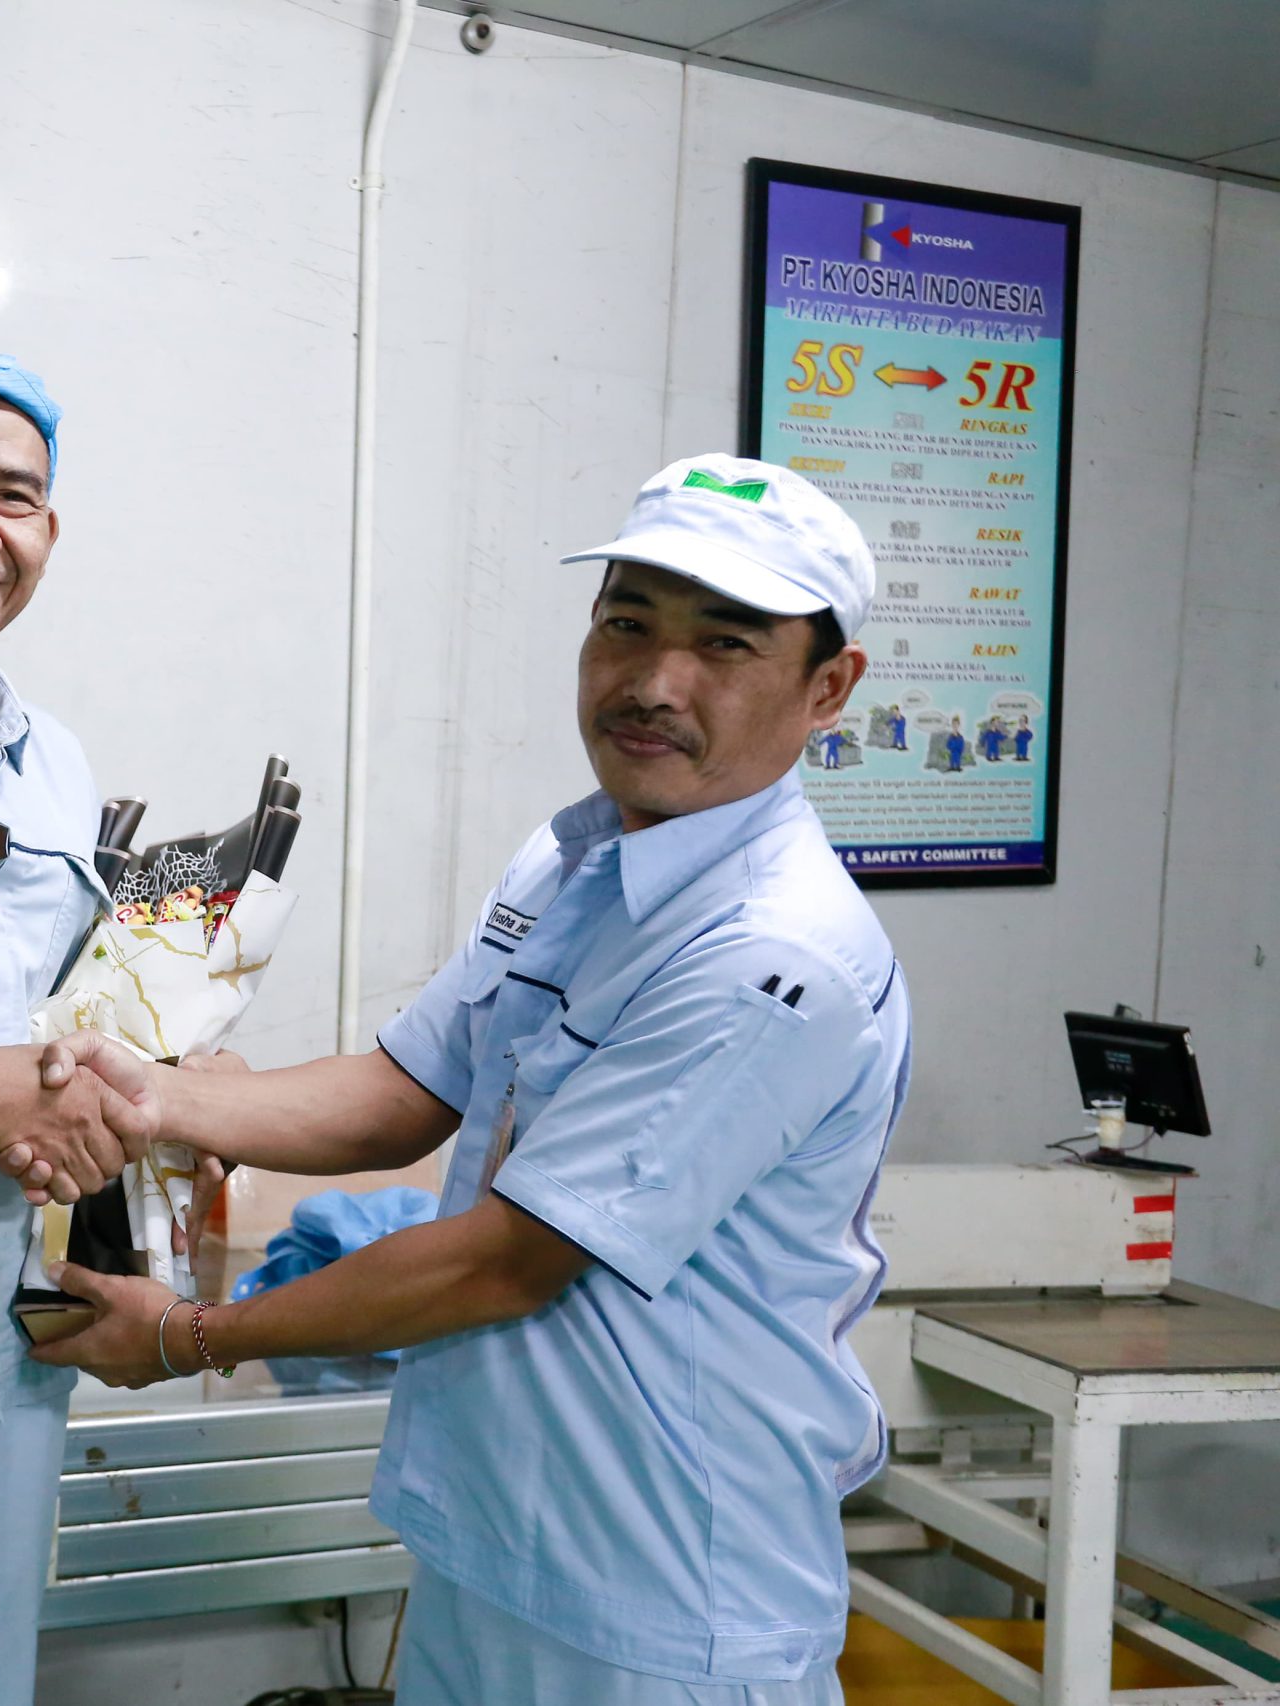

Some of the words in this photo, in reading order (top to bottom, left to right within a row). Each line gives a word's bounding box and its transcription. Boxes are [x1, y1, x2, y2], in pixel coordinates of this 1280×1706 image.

[911, 232, 974, 250] KYOSHA
[781, 255, 815, 289] PT.
[821, 262, 917, 302] KYOSHA
[923, 274, 1045, 316] INDONESIA
[785, 299, 843, 324] MARI
[848, 306, 901, 330] KITA
[786, 340, 863, 397] 5S
[959, 360, 1038, 412] 5R
[960, 418, 1028, 435] RINGKAS
[779, 422, 828, 434] PISAHKAN
[903, 434, 936, 444] BENAR
[938, 436, 972, 446] BENAR
[974, 439, 1038, 450] DIPERLUKAN
[801, 435, 822, 445] DAN
[918, 446, 948, 456] TIDAK
[950, 449, 1014, 460] DIPERLUKAN
[988, 471, 1024, 486] RAPI
[1012, 493, 1035, 501] RAPI
[976, 528, 1023, 542] RESIK
[969, 587, 1022, 600] RAWAT
[972, 643, 1019, 656] RAJIN
[847, 851, 858, 864] &
[862, 849, 918, 864] SAFETY
[923, 848, 1007, 863] COMMITTEE
